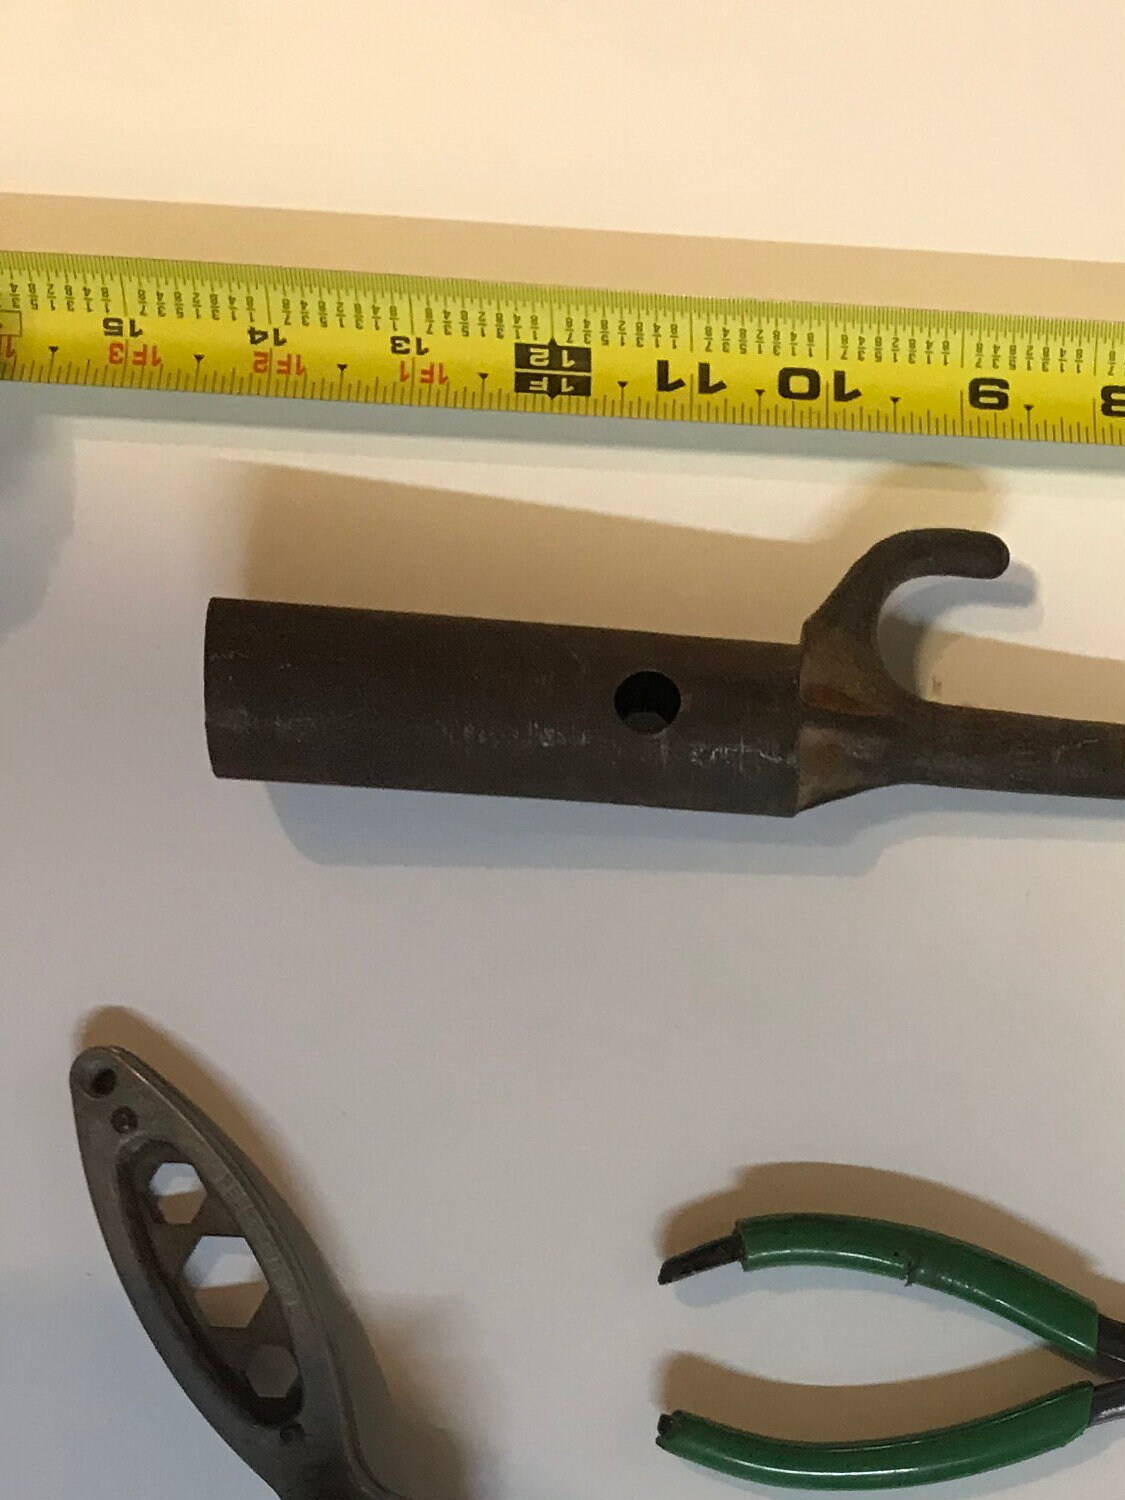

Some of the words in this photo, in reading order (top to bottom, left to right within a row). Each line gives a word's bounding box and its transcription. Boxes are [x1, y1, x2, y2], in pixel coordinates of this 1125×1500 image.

[103, 318, 142, 336] 15
[248, 327, 286, 345] 14
[110, 343, 124, 364] 3
[391, 337, 428, 355] 13
[132, 347, 160, 366] 1F
[254, 352, 268, 372] 2
[277, 355, 305, 375] 1F
[528, 347, 575, 367] 12
[400, 363, 409, 381] 1
[420, 365, 447, 384] 1F
[657, 360, 726, 394] 11
[528, 376, 576, 393] 1F
[779, 368, 861, 401] 10
[969, 378, 1009, 410] 9
